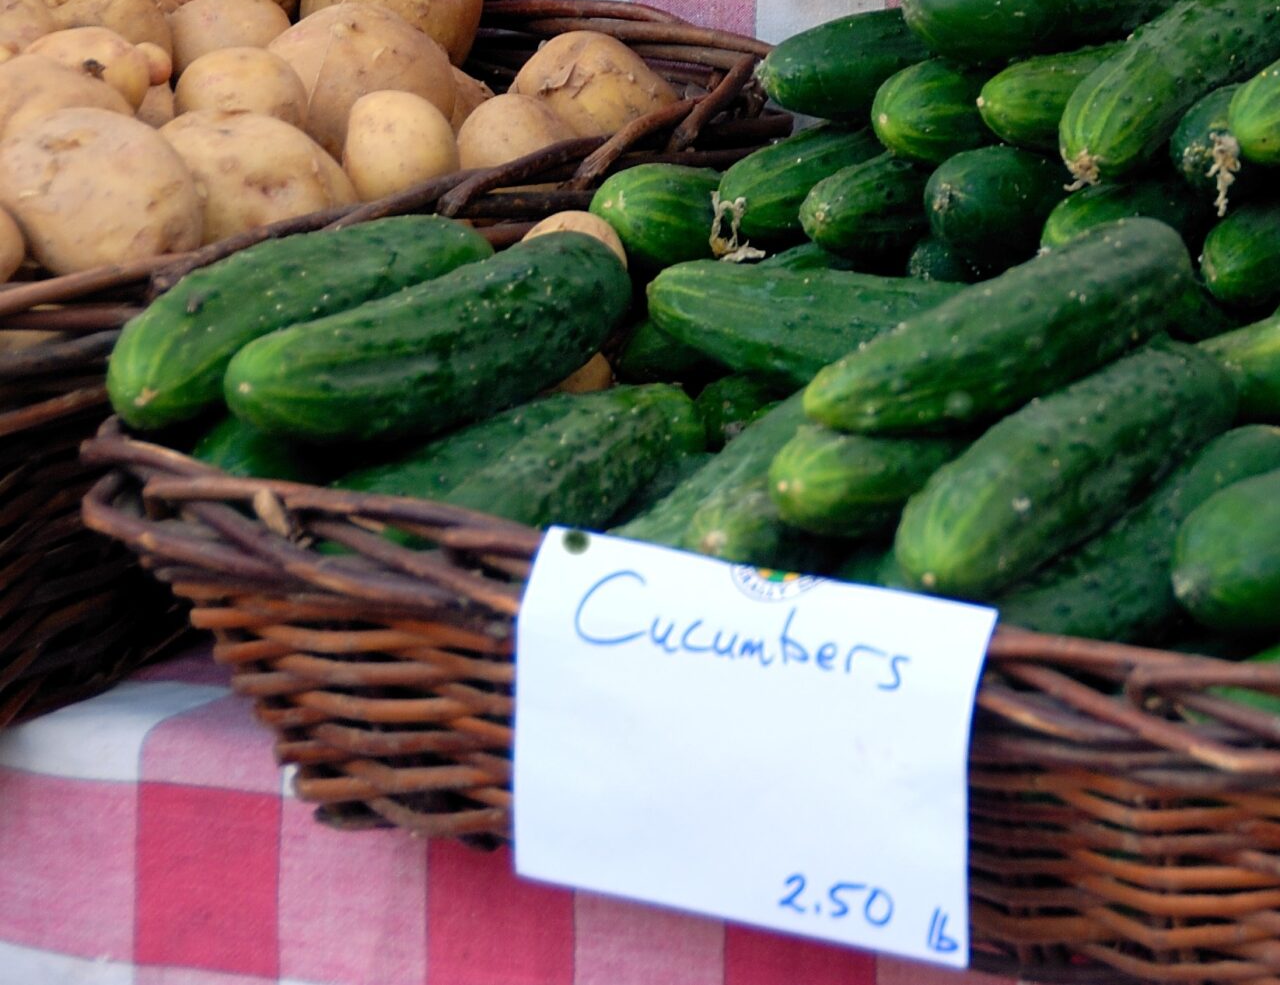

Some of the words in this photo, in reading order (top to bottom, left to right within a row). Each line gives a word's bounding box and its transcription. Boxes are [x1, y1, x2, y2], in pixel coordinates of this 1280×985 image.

[573, 568, 913, 692] Cucumbers
[777, 871, 896, 927] 2.50
[926, 905, 960, 954] lb
